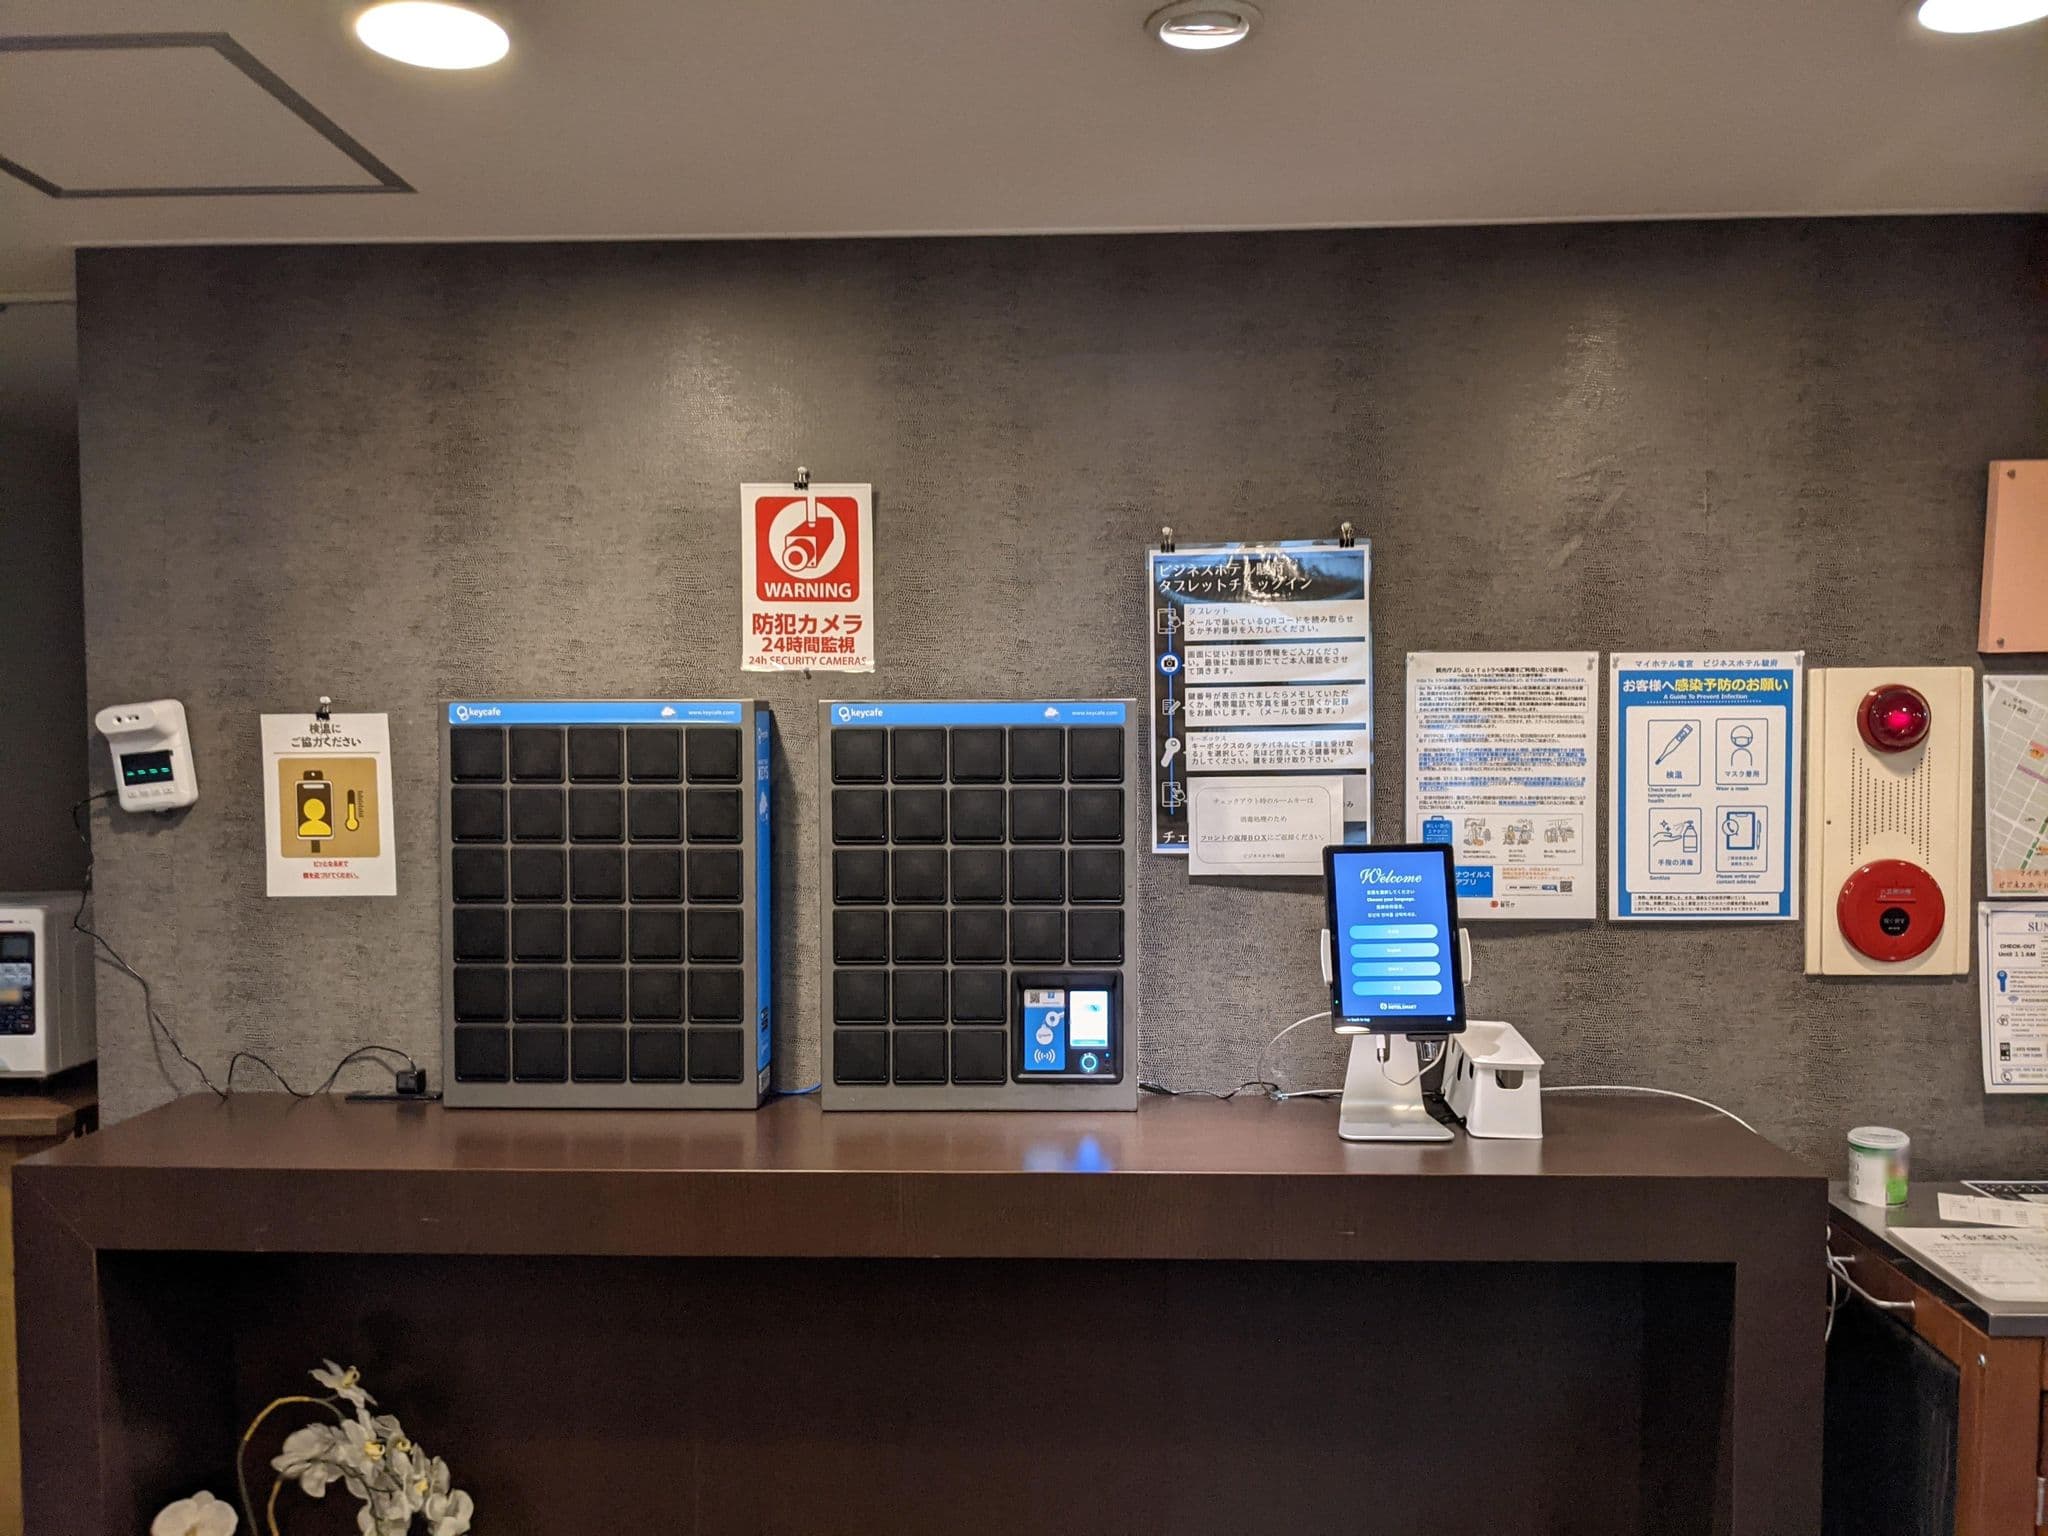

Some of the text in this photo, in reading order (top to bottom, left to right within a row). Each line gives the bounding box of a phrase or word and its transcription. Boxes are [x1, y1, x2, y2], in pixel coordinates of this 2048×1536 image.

[764, 582, 852, 598] WARNING
[752, 613, 863, 635] 防犯カメラ
[761, 636, 855, 654] 24時間監視
[749, 656, 867, 666] 24h SECURITY CAMERAS
[1623, 678, 1789, 692] お客様へ感染予防のお願い
[469, 707, 501, 717] keycafe
[851, 707, 883, 718] keycafe
[309, 723, 342, 734] 検温に
[291, 736, 361, 748] ご協力ください
[1360, 867, 1422, 885] Welcome
